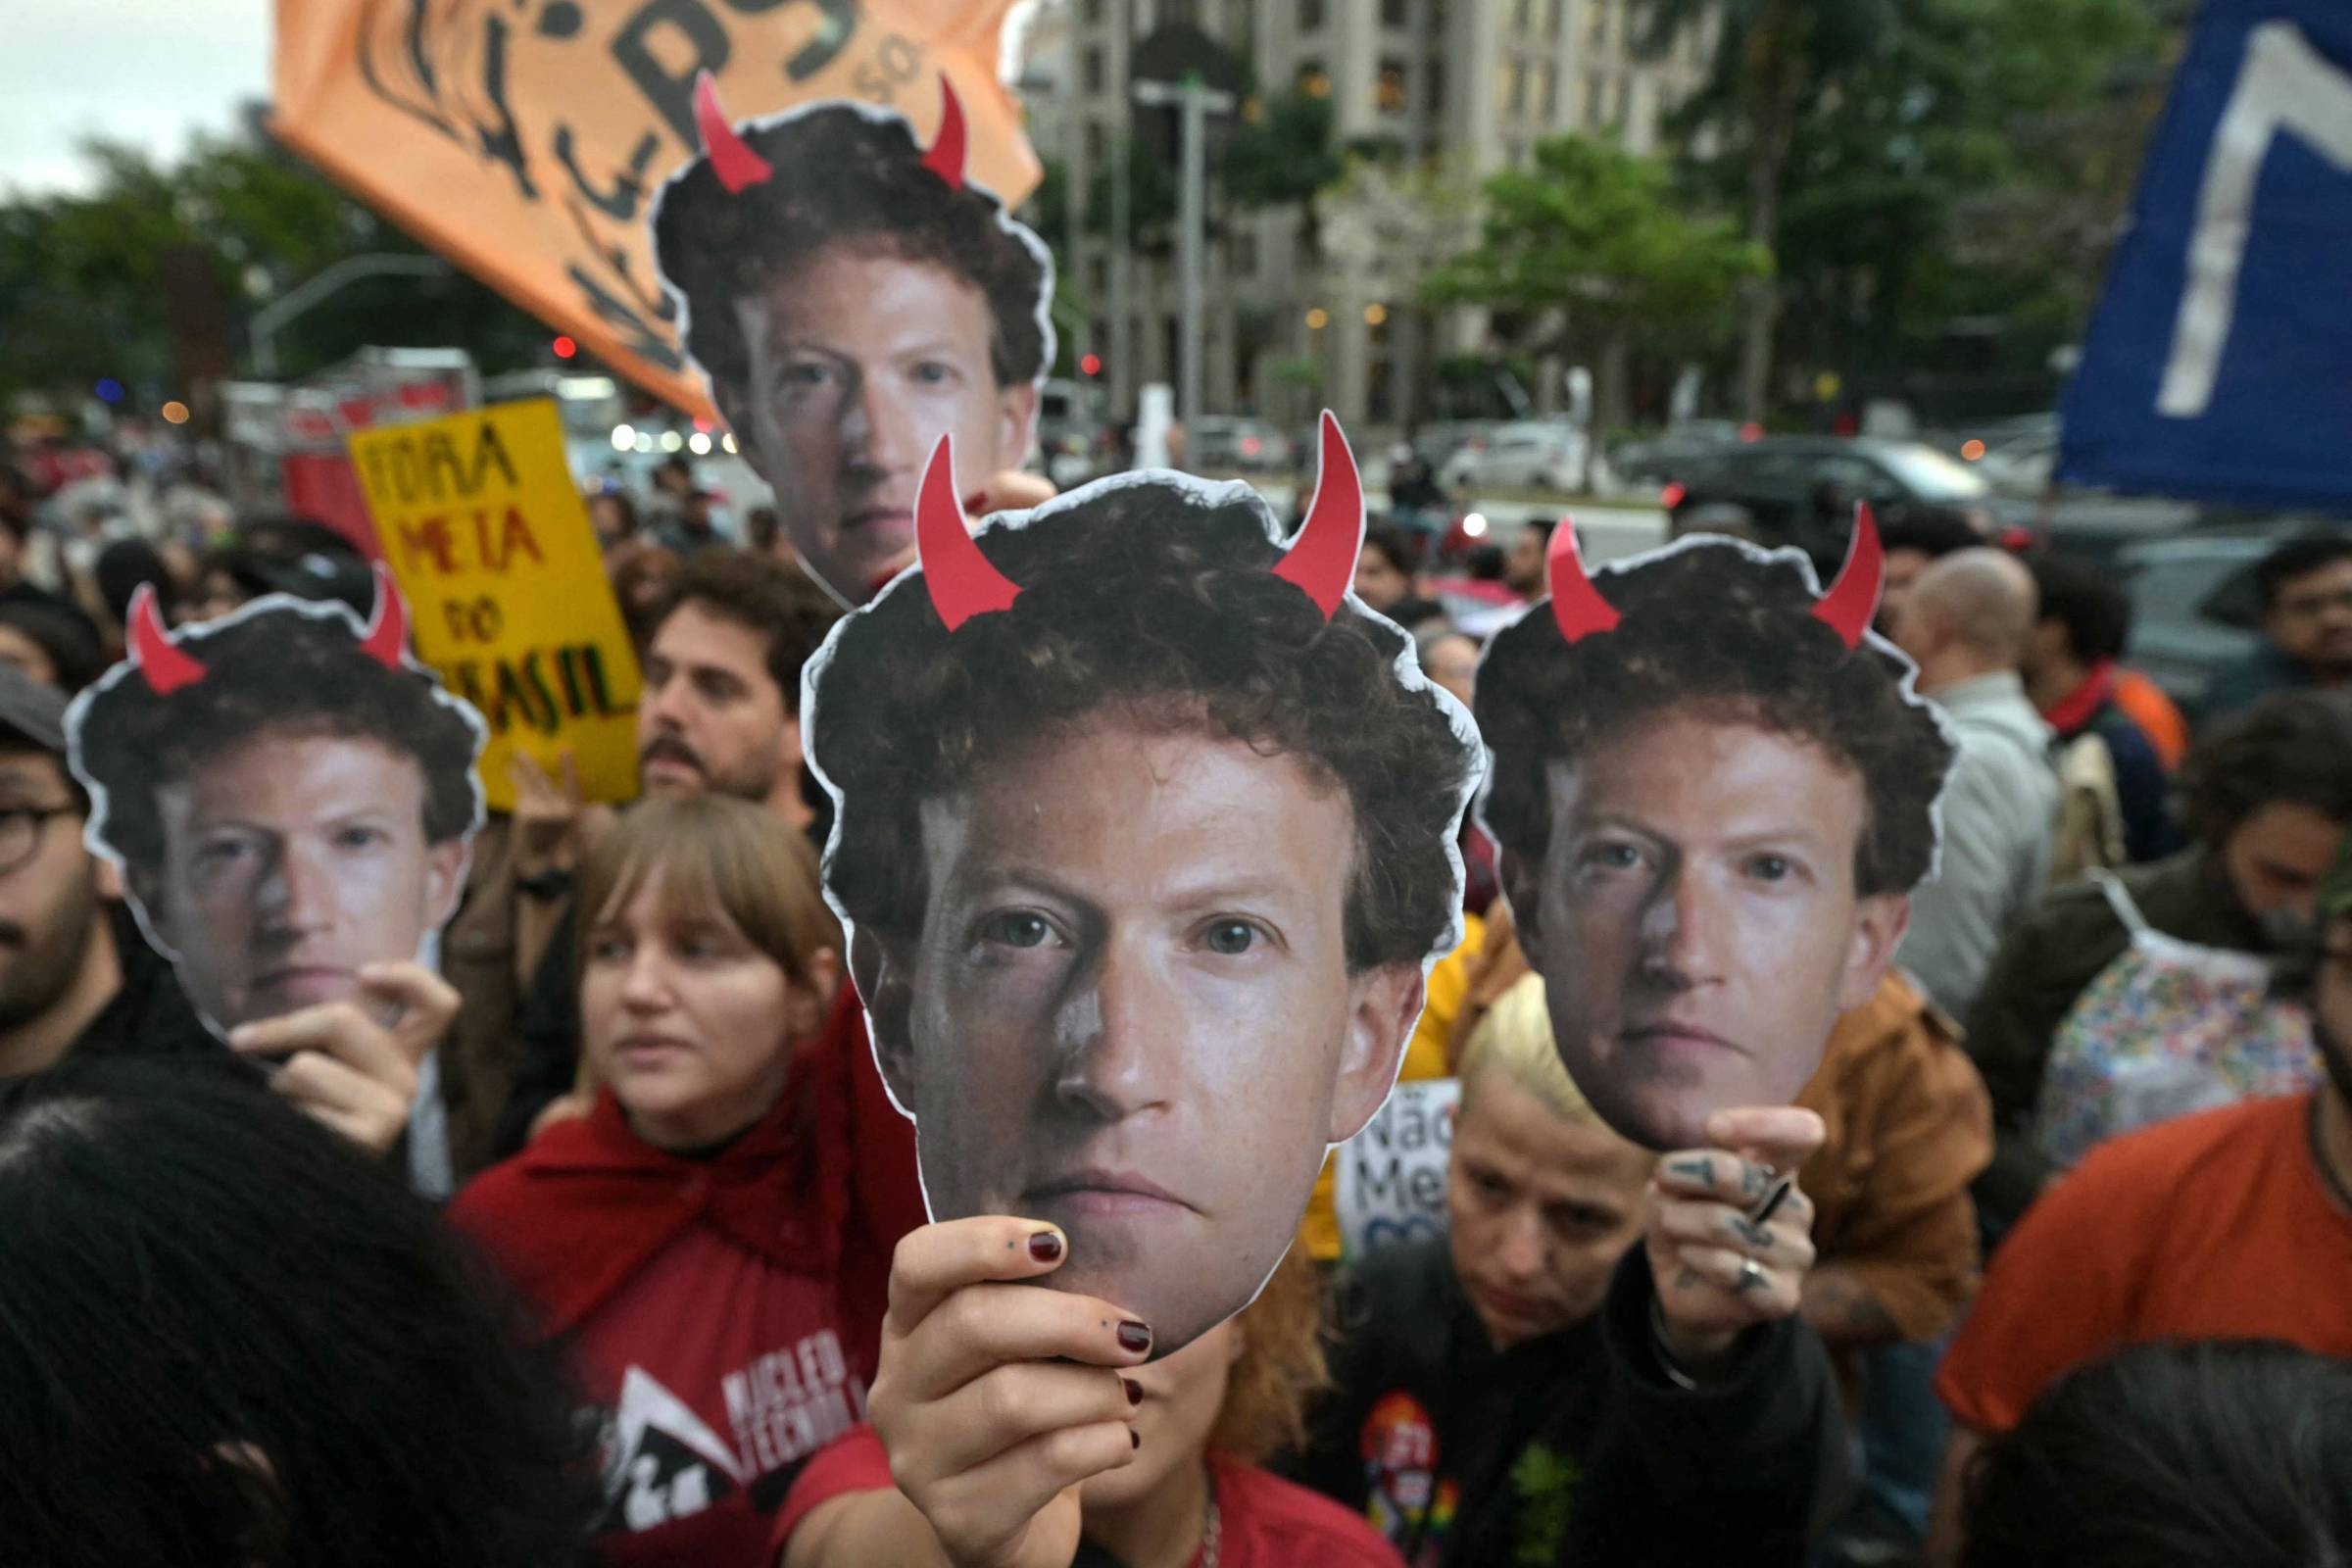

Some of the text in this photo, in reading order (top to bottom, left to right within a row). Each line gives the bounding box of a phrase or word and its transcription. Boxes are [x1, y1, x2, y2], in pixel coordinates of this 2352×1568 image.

[363, 421, 519, 504] FORA
[396, 503, 545, 577] META
[441, 643, 637, 737] RASIL
